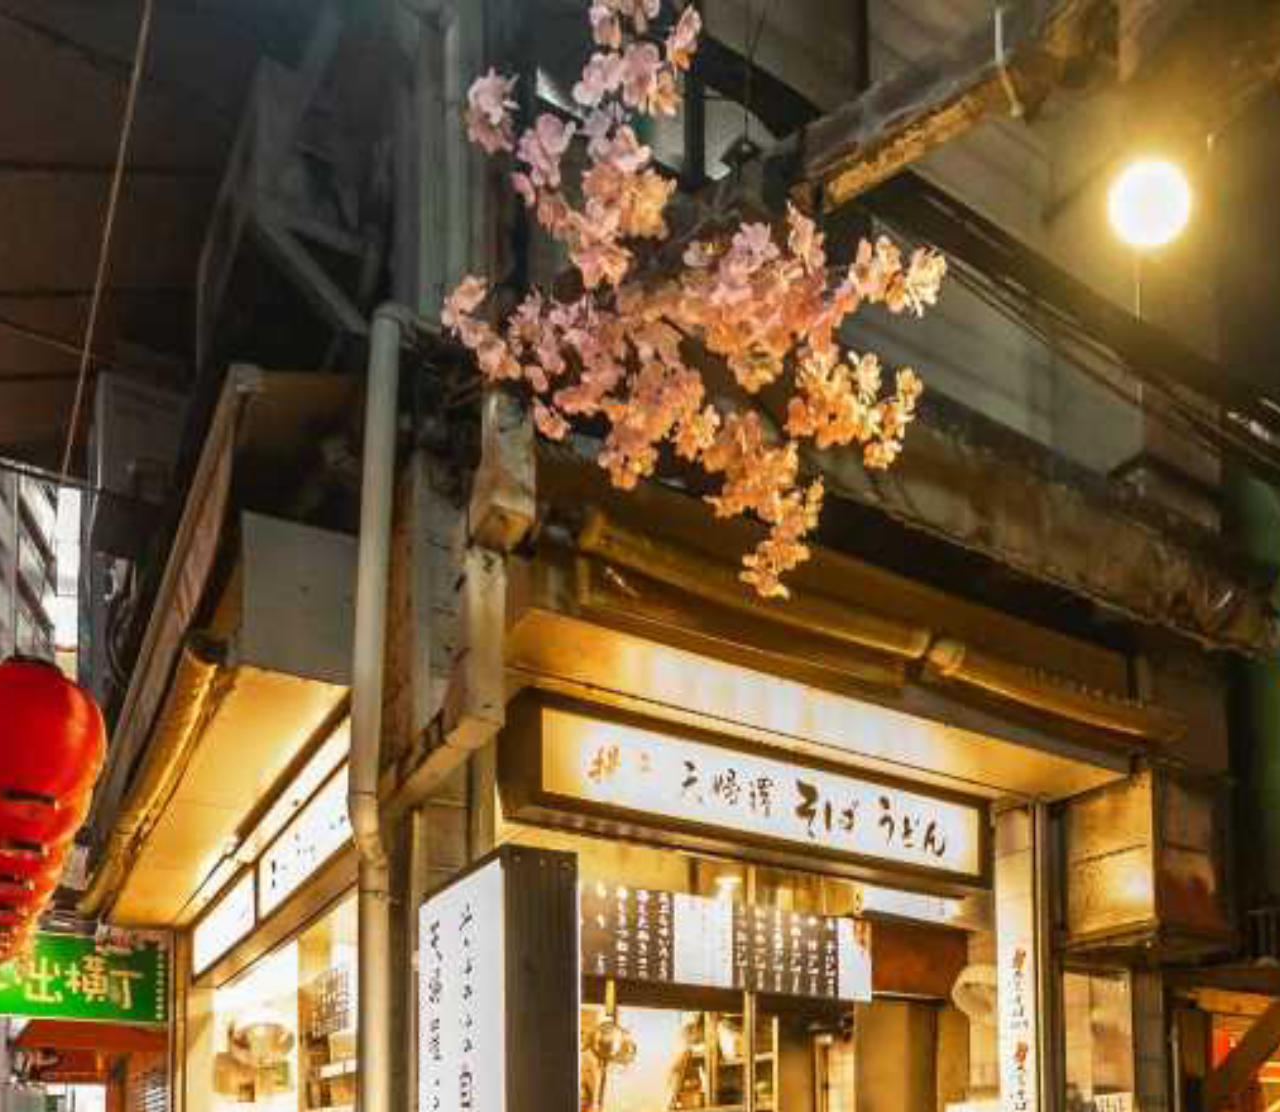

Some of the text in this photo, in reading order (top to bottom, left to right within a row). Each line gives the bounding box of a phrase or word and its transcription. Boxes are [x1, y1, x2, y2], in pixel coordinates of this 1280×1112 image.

[794, 778, 860, 839] そば
[878, 795, 947, 858] うどん
